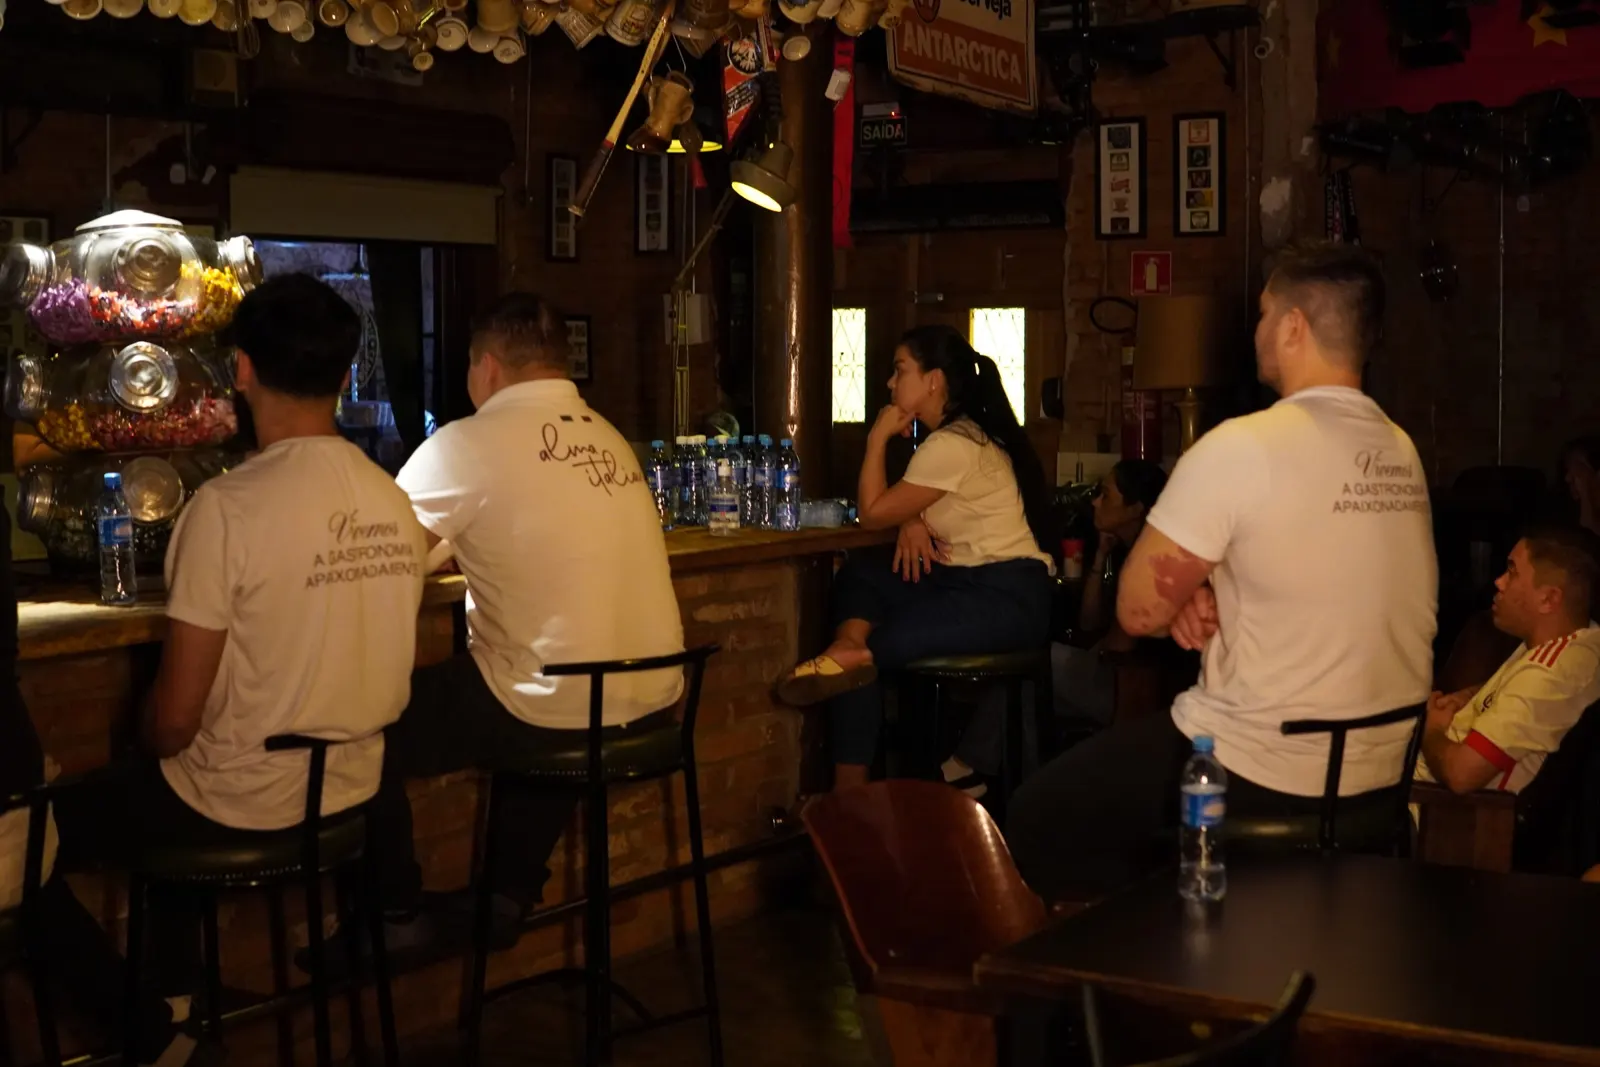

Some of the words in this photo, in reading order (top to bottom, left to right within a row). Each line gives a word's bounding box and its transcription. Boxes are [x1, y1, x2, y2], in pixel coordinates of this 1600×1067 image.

[960, 0, 1011, 20] veja
[903, 20, 1022, 85] ANTARCTICA
[862, 120, 904, 141] SAÍDA
[572, 449, 643, 497] itali
[1342, 482, 1352, 496] A
[1354, 482, 1425, 496] GASTRONO
[1332, 500, 1430, 515] APAIXONADAE
[314, 553, 325, 568] A
